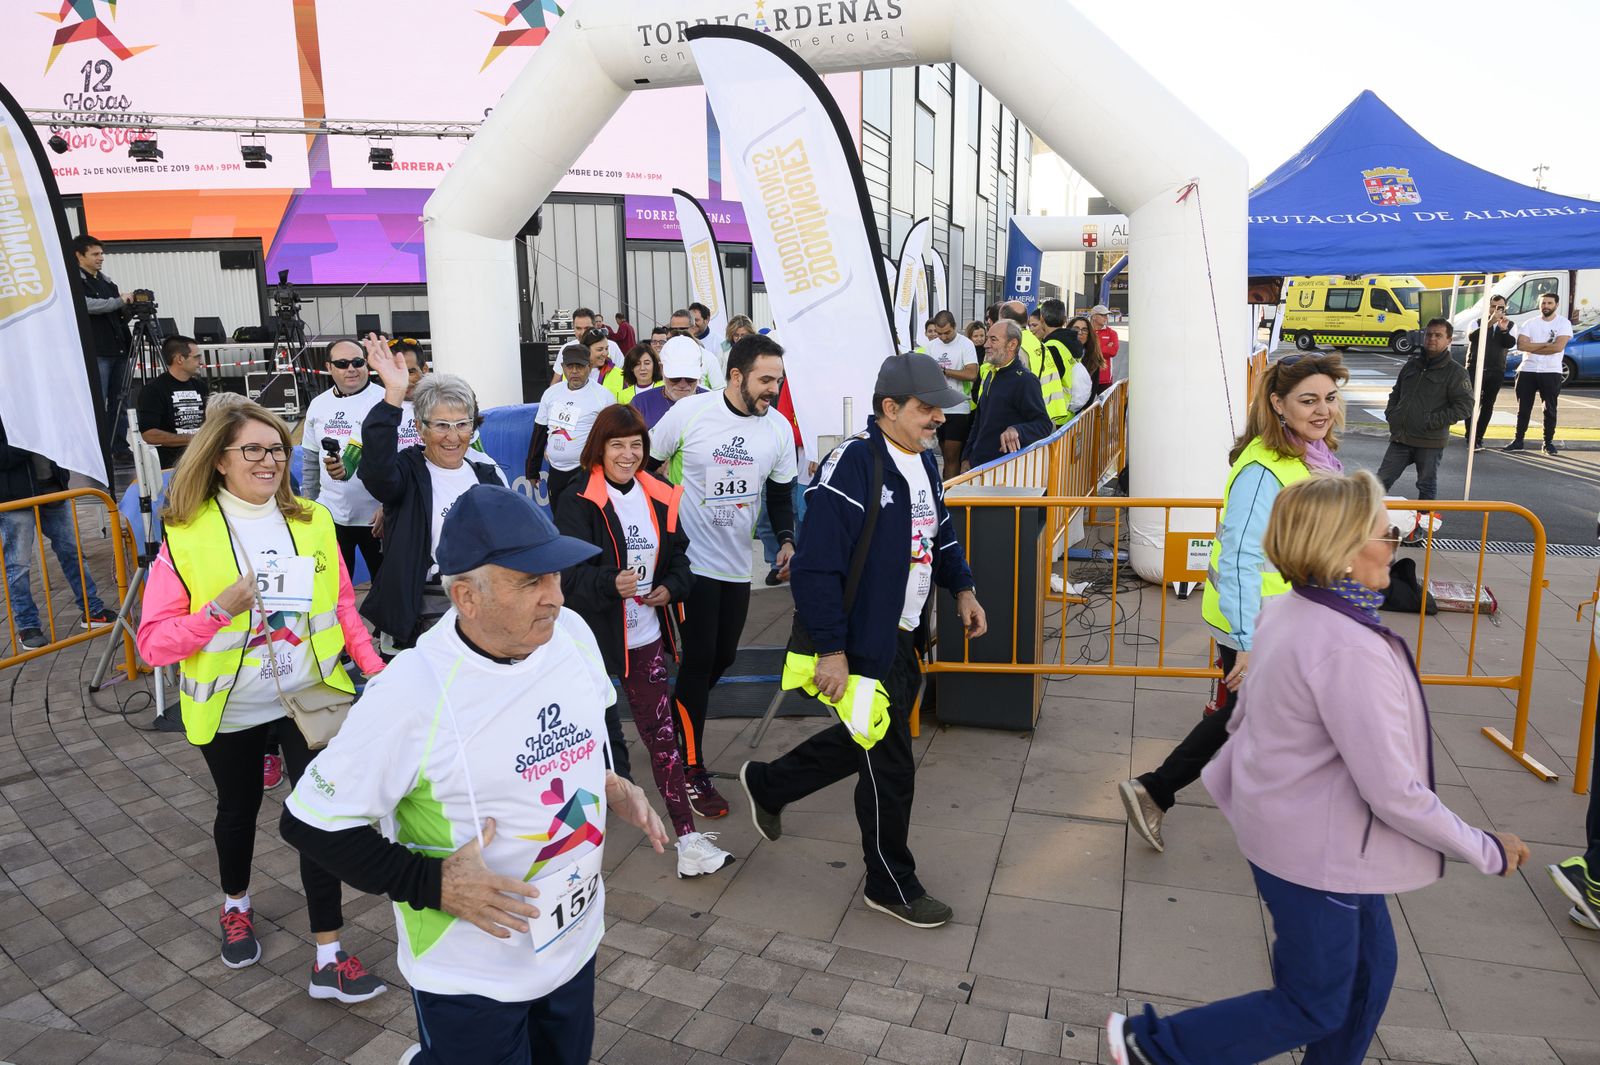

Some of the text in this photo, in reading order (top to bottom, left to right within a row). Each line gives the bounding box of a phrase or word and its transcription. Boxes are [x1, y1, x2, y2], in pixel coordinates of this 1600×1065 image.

[638, 0, 903, 46] TORCARDENAS
[789, 26, 904, 49] mercial
[80, 59, 113, 93] 12
[63, 92, 132, 111] Horas
[52, 163, 241, 177] RCHA 24 DE NOVIEMBRE DE 2019 9AM 9PM
[392, 161, 445, 171] ARRERA
[593, 169, 604, 177] DE
[605, 170, 623, 178] 2019
[625, 171, 643, 179] 9AM
[636, 209, 732, 224] TORREENAS
[1247, 206, 1600, 225] IPUTACIÓN DE ALMERÍA
[334, 411, 345, 420] 12
[558, 412, 571, 422] 66
[721, 444, 748, 456] Horas
[731, 436, 745, 448] 12
[712, 448, 754, 462] Solidarias
[713, 479, 747, 496] 343
[627, 525, 639, 537] 12
[626, 542, 655, 550] idarias
[256, 573, 285, 593] 51
[260, 663, 293, 680] PERGRIN
[536, 703, 562, 733] 12
[525, 722, 578, 752] Horas
[515, 728, 593, 773] Solidarias
[521, 739, 597, 782] Non Stop
[550, 873, 599, 930] 152
